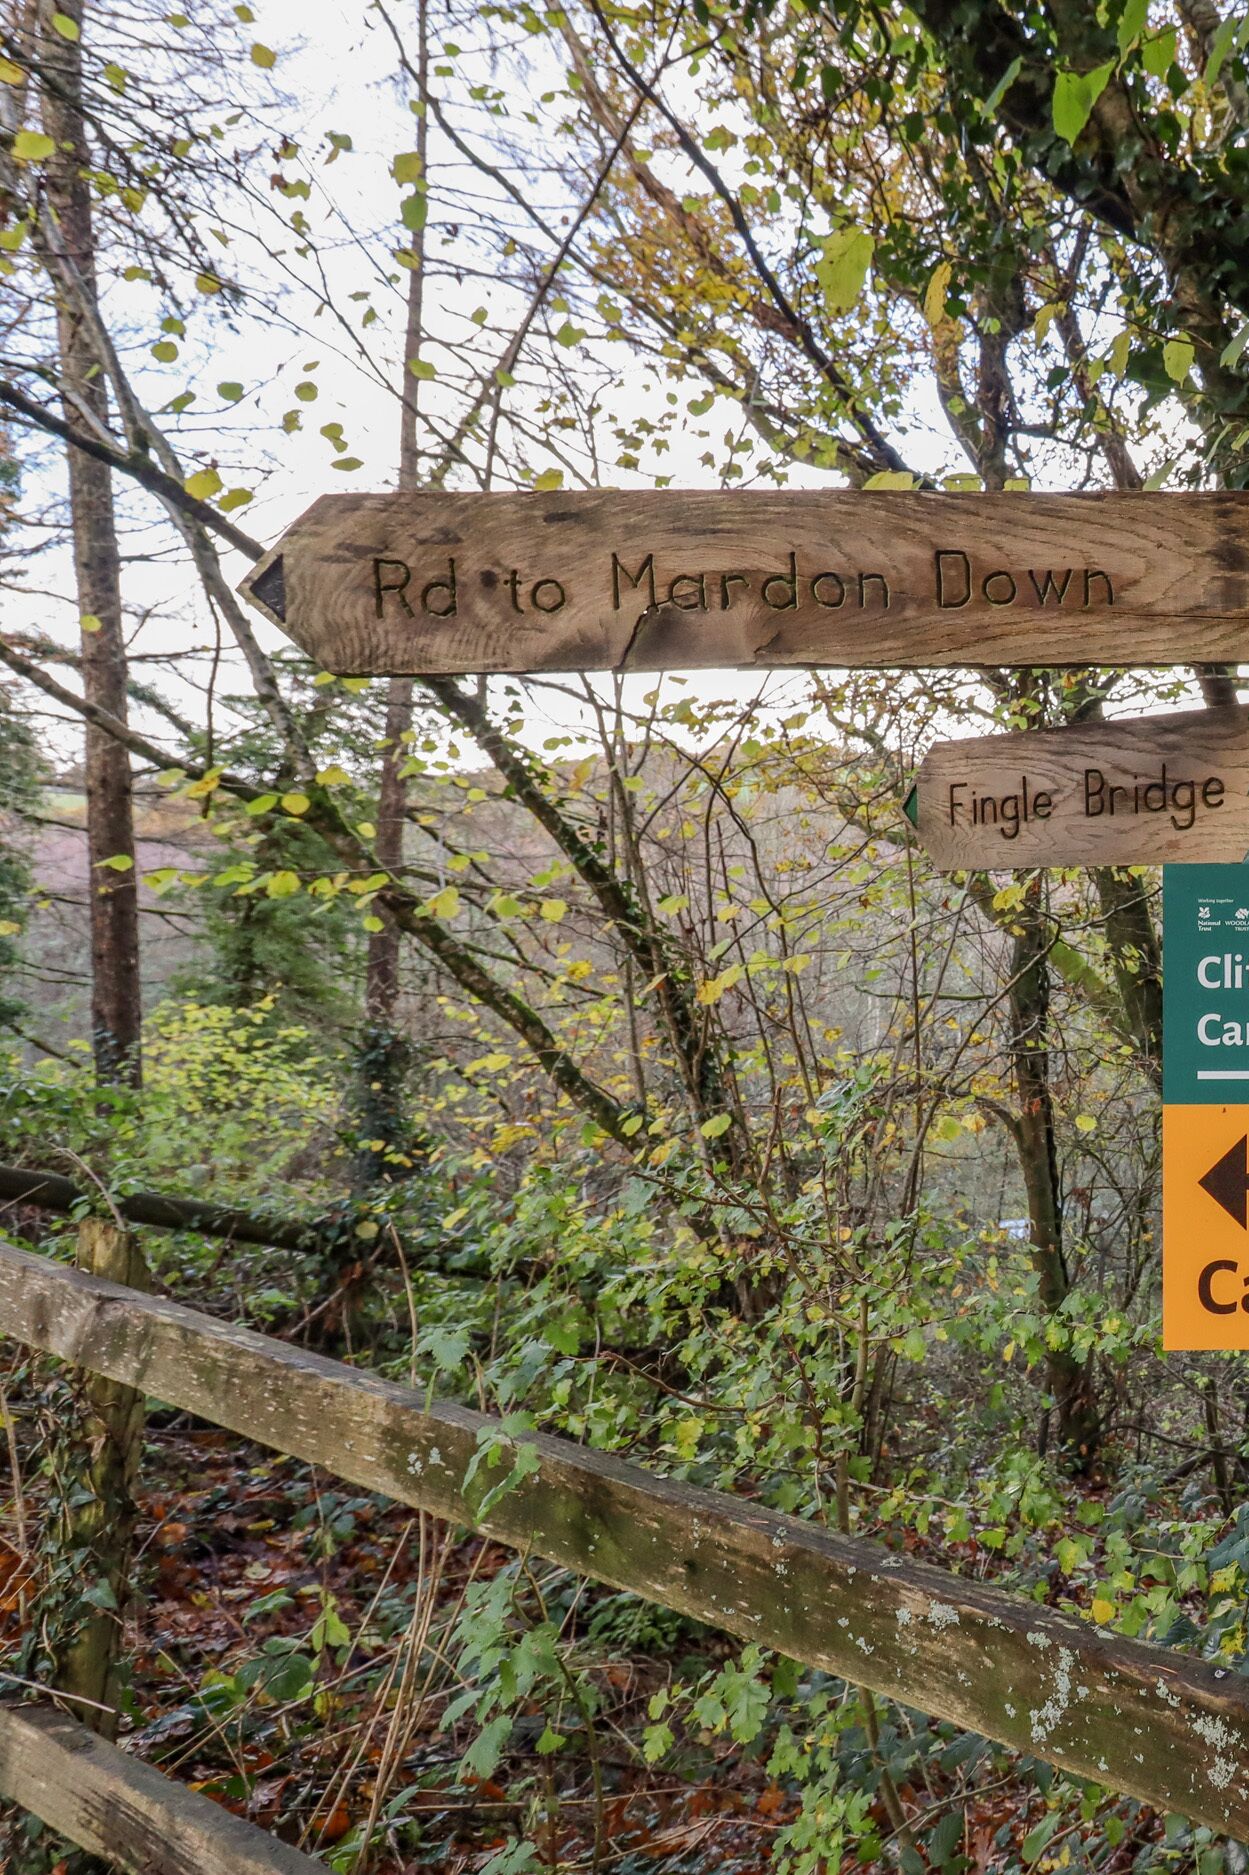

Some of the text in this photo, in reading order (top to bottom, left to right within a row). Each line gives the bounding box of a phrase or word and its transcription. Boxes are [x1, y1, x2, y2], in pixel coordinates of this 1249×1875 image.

[374, 549, 1115, 619] Rd to Mardon Down
[949, 763, 1226, 840] Fingle Bridge
